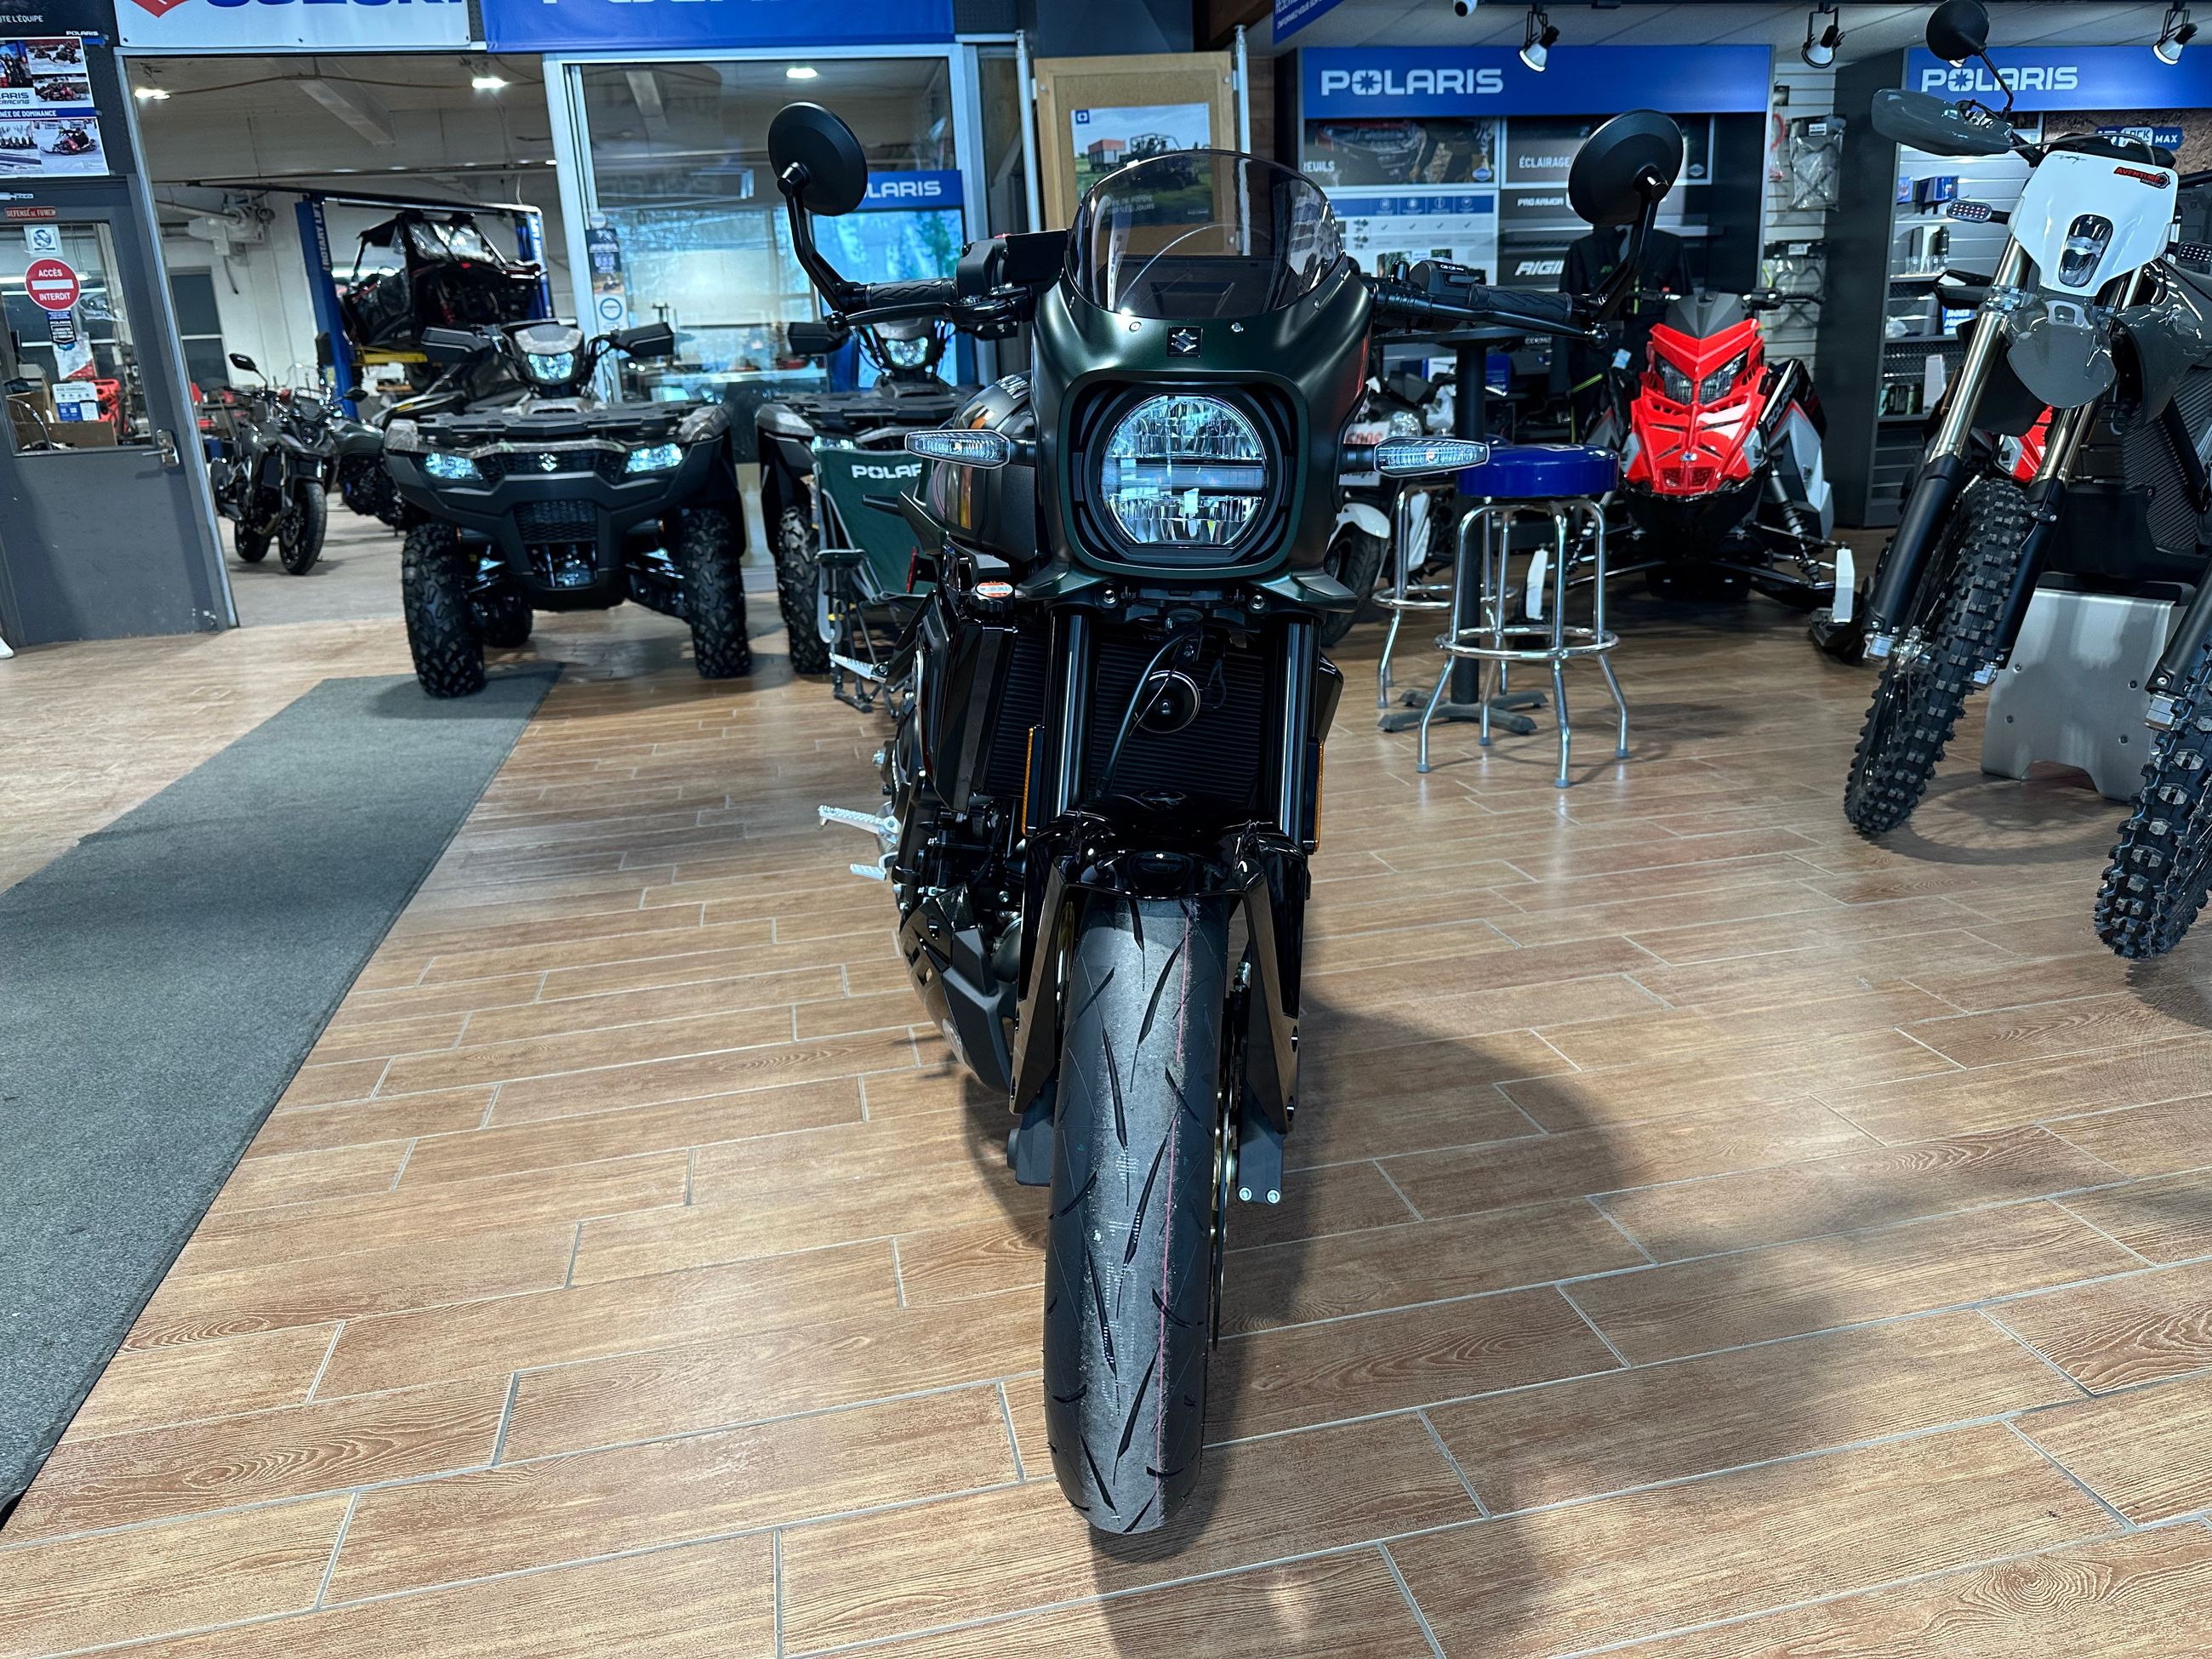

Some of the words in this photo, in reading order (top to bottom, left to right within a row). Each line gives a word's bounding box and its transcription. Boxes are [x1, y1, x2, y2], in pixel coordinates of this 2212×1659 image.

[1321, 68, 1503, 95] POLARIS
[1921, 66, 2078, 92] POLARIS
[2155, 135, 2178, 144] MAX
[1519, 155, 1571, 168] ÉCLAIRAGE
[864, 180, 942, 198] LARIS
[313, 202, 322, 224] LIFT
[316, 226, 329, 265] ROTARY
[38, 267, 63, 277] ACCÈS
[39, 293, 71, 301] INTERDIT
